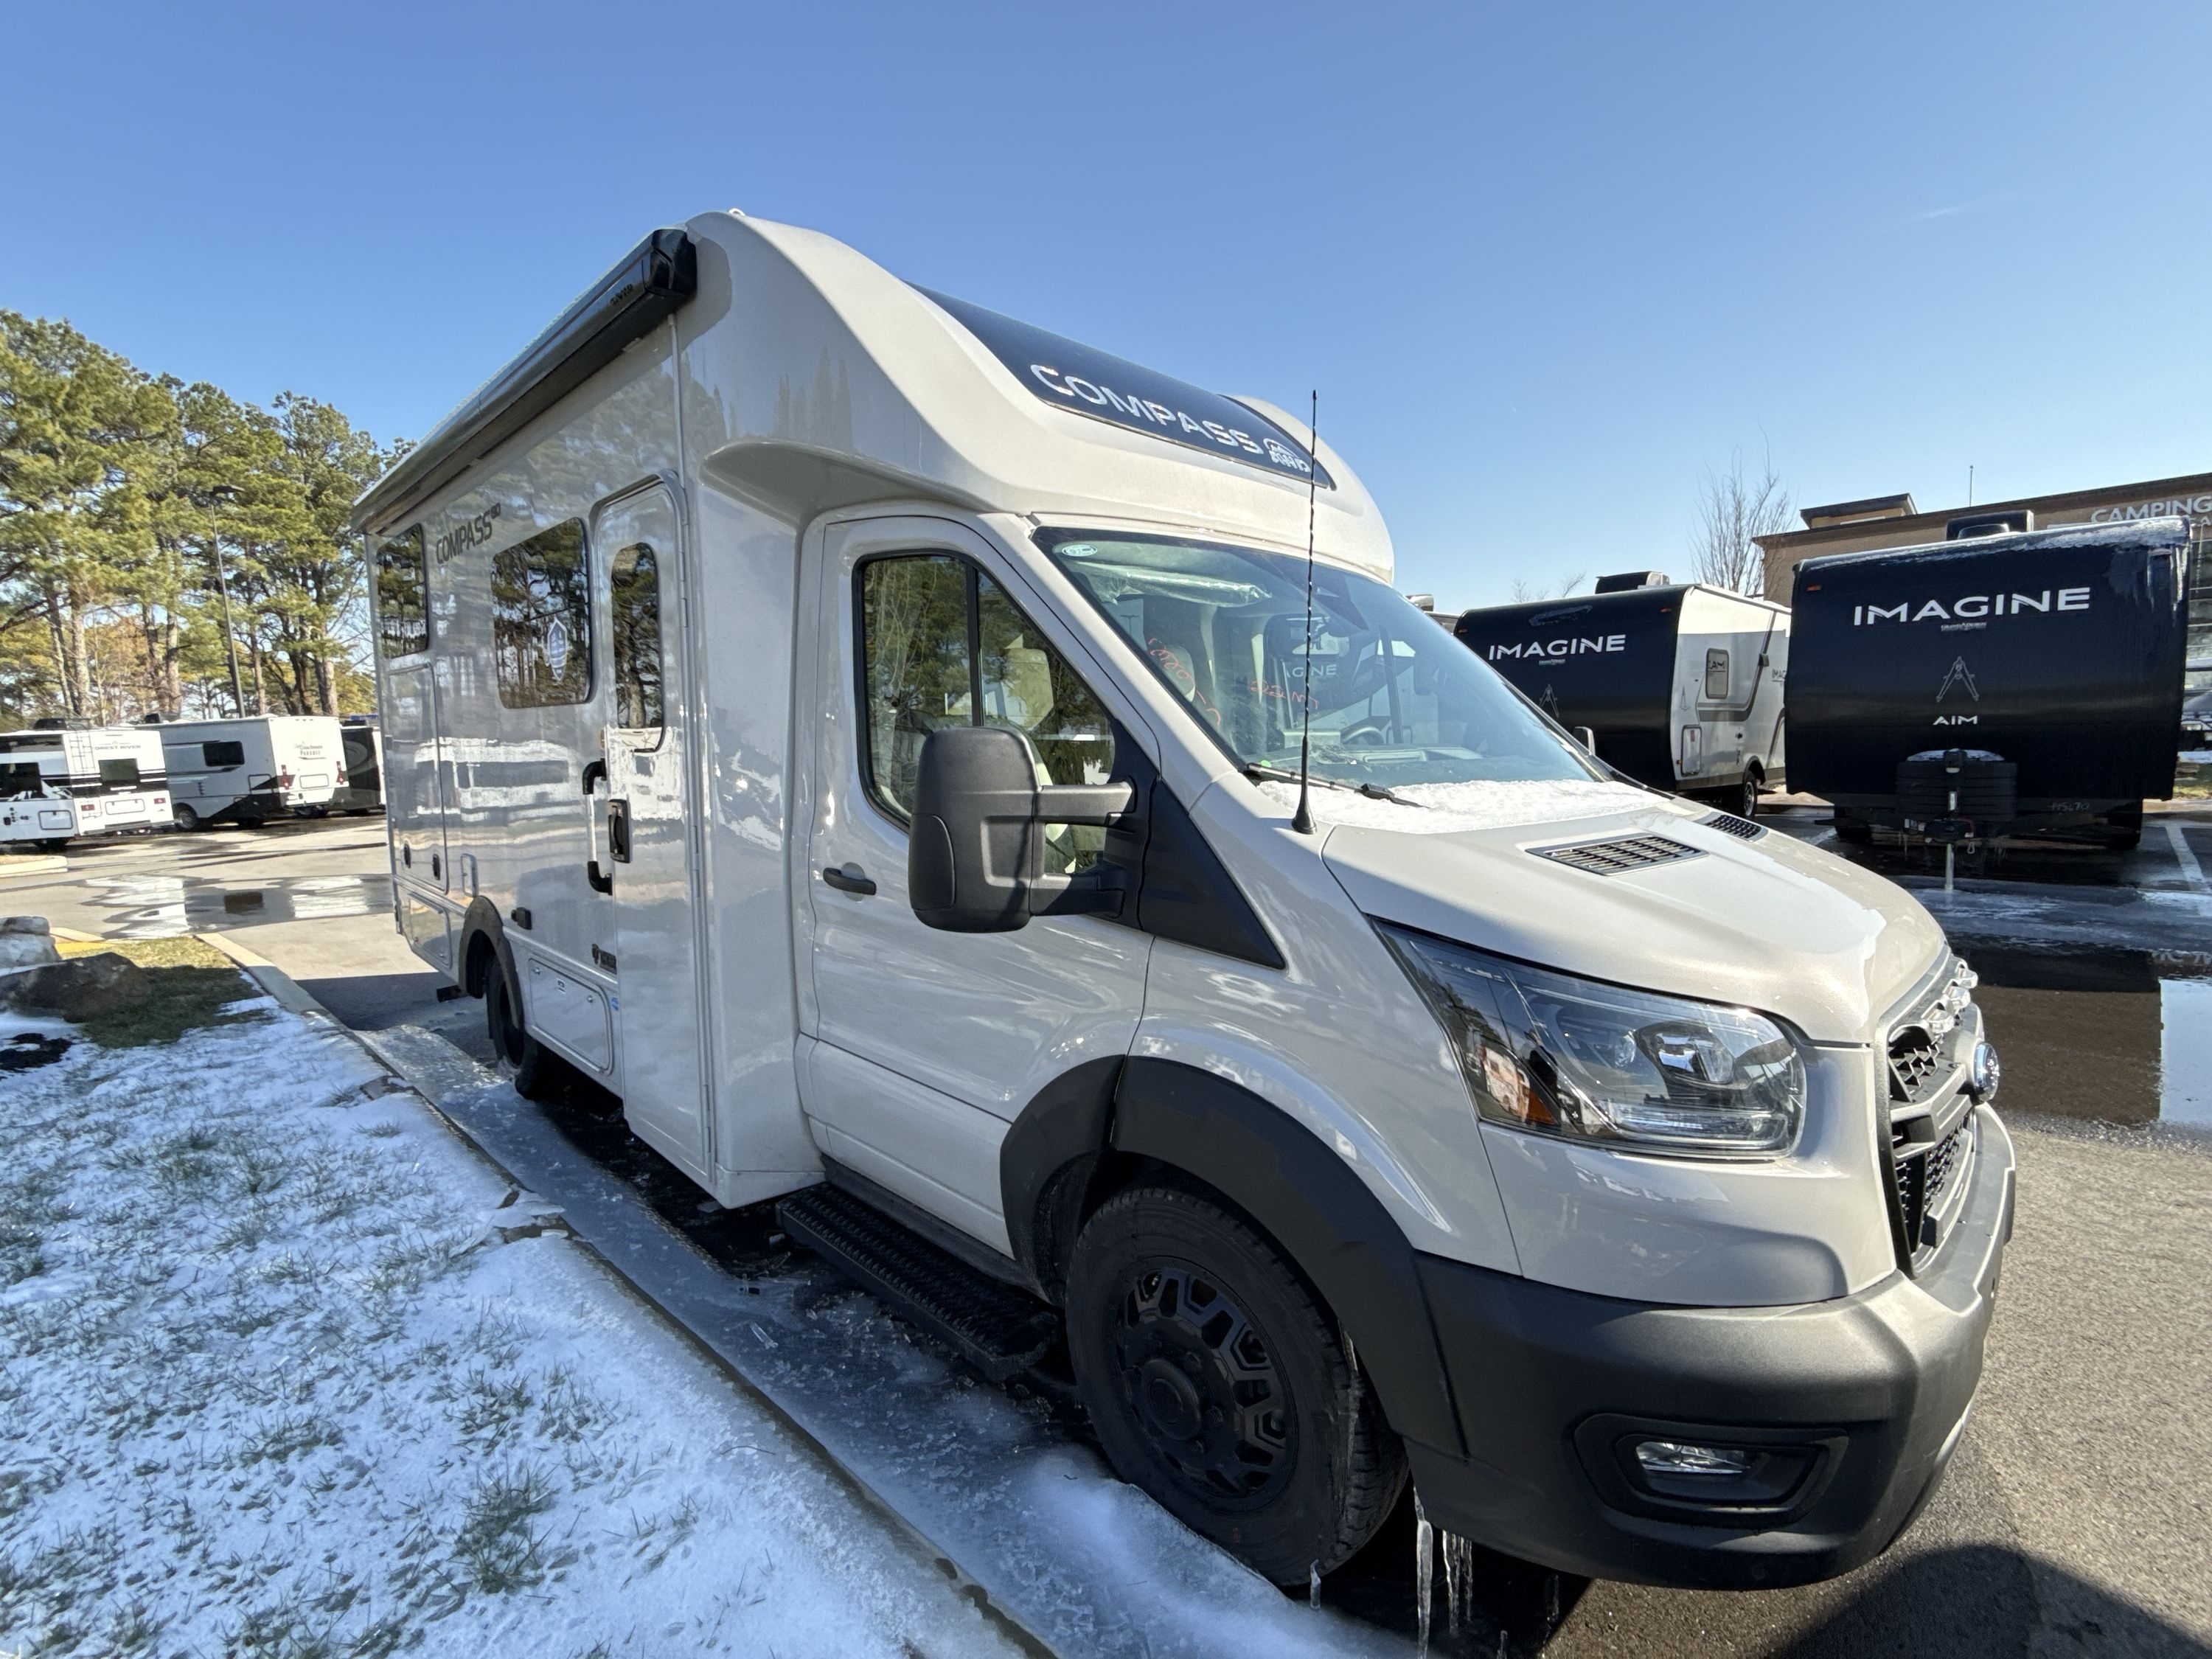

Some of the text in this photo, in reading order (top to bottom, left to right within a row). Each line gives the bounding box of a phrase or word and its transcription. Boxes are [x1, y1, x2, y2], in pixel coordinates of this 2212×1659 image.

[1030, 364, 1264, 455] COMPASS
[2090, 495, 2212, 524] CAMPING
[436, 509, 493, 564] COMPASS
[1853, 587, 2091, 627] IMAGINE
[1488, 633, 1627, 661] IMAGINE
[1932, 715, 1978, 726] AIM
